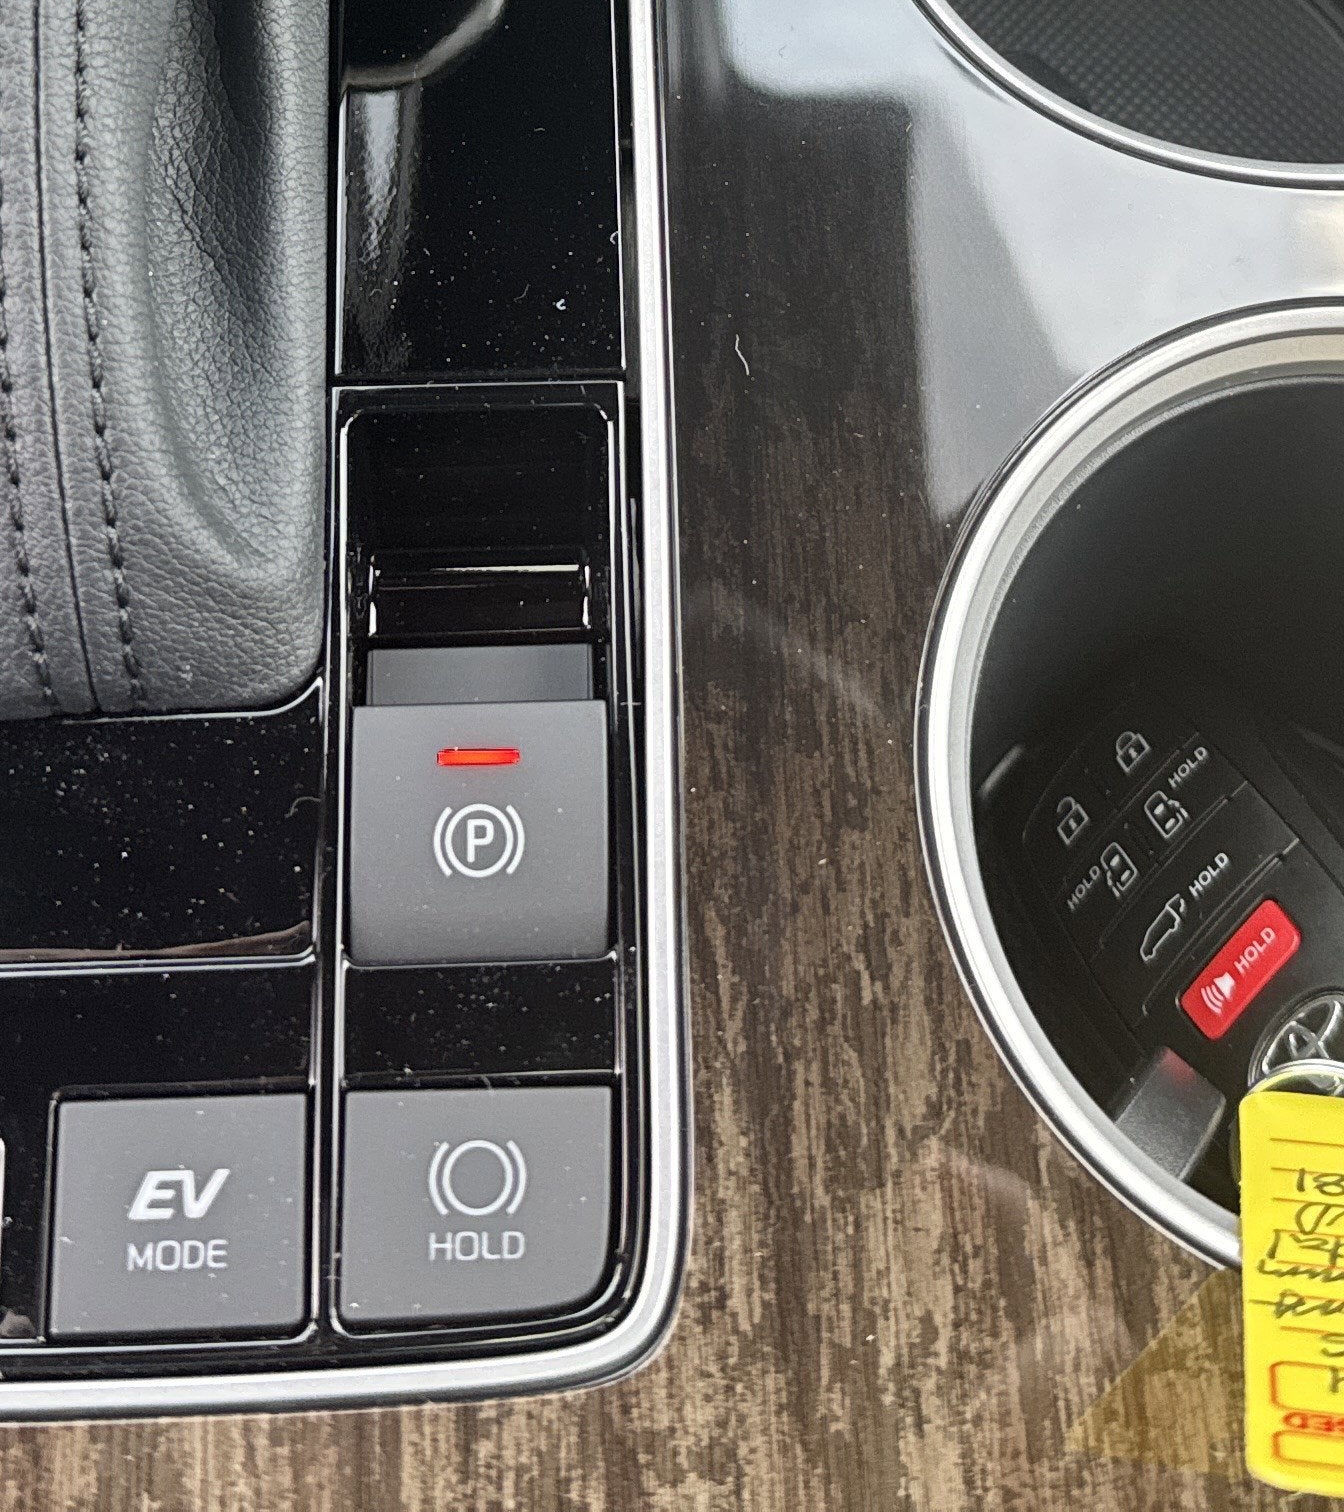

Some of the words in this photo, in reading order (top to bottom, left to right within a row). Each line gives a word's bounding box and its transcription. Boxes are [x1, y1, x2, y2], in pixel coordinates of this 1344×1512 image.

[1167, 745, 1209, 789] HOLD
[466, 818, 494, 863] P
[1067, 864, 1104, 911] HOLD
[1187, 851, 1230, 897] HOLD
[1233, 926, 1277, 977] HOLD
[127, 1168, 230, 1221] EV
[126, 1238, 228, 1272] MODE
[427, 1231, 526, 1261] HOLD
